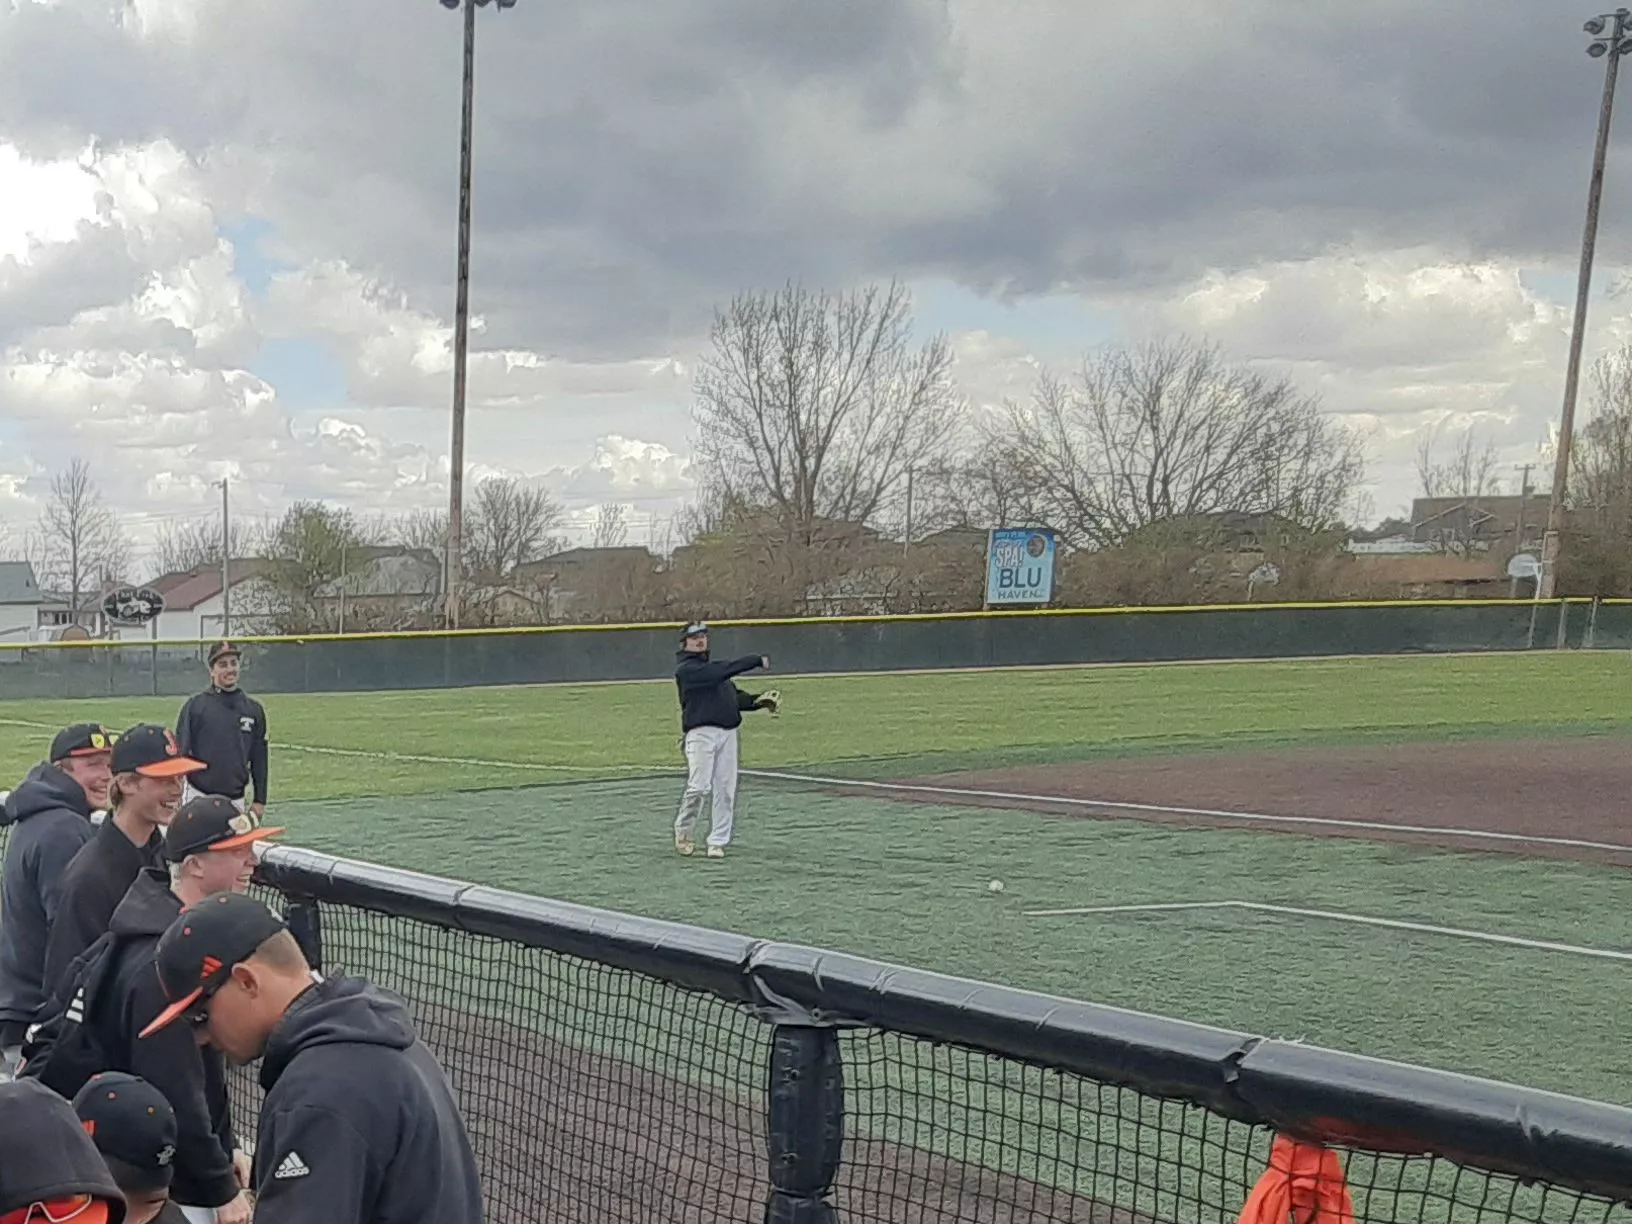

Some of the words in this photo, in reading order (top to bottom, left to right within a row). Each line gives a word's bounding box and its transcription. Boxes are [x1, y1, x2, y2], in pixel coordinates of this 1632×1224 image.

[999, 567, 1042, 588] BLU
[998, 590, 1037, 599] HAVEN
[274, 1166, 309, 1179] adidas
